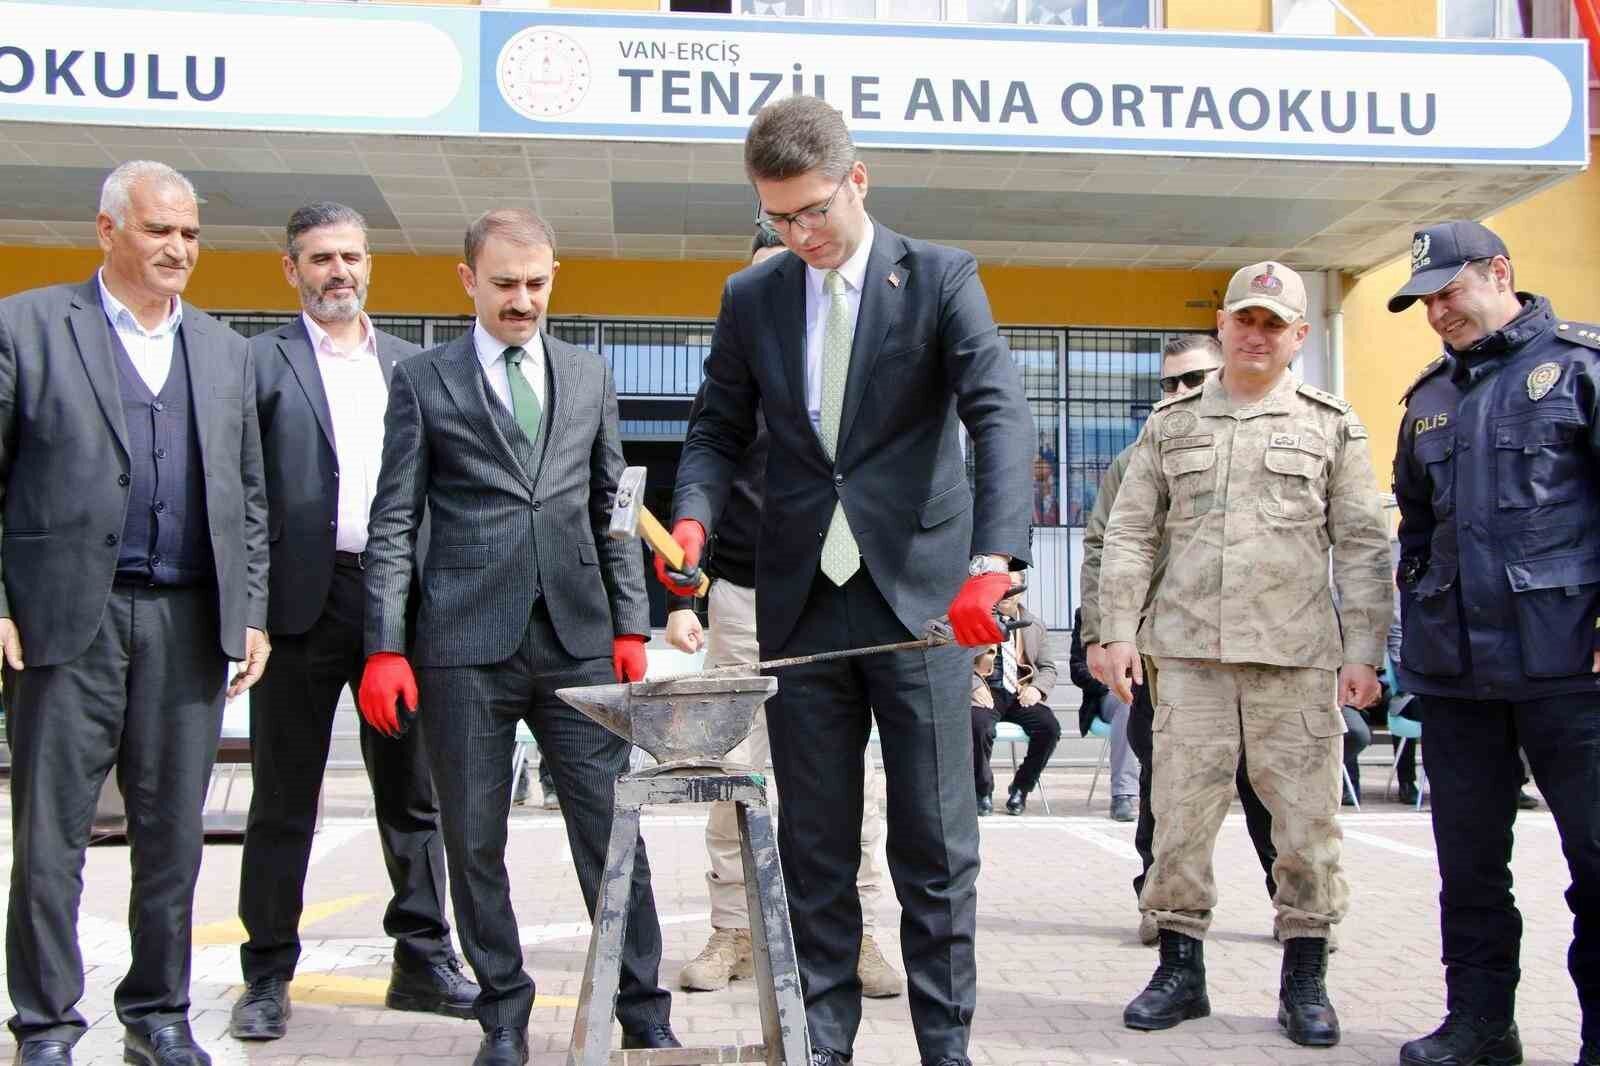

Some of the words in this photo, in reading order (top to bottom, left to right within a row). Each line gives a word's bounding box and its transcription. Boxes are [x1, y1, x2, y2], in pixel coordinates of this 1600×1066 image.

[618, 39, 740, 66] VAN-ERCİŞ
[904, 77, 1038, 123] ANA
[1061, 82, 1436, 136] ORTAOKULU
